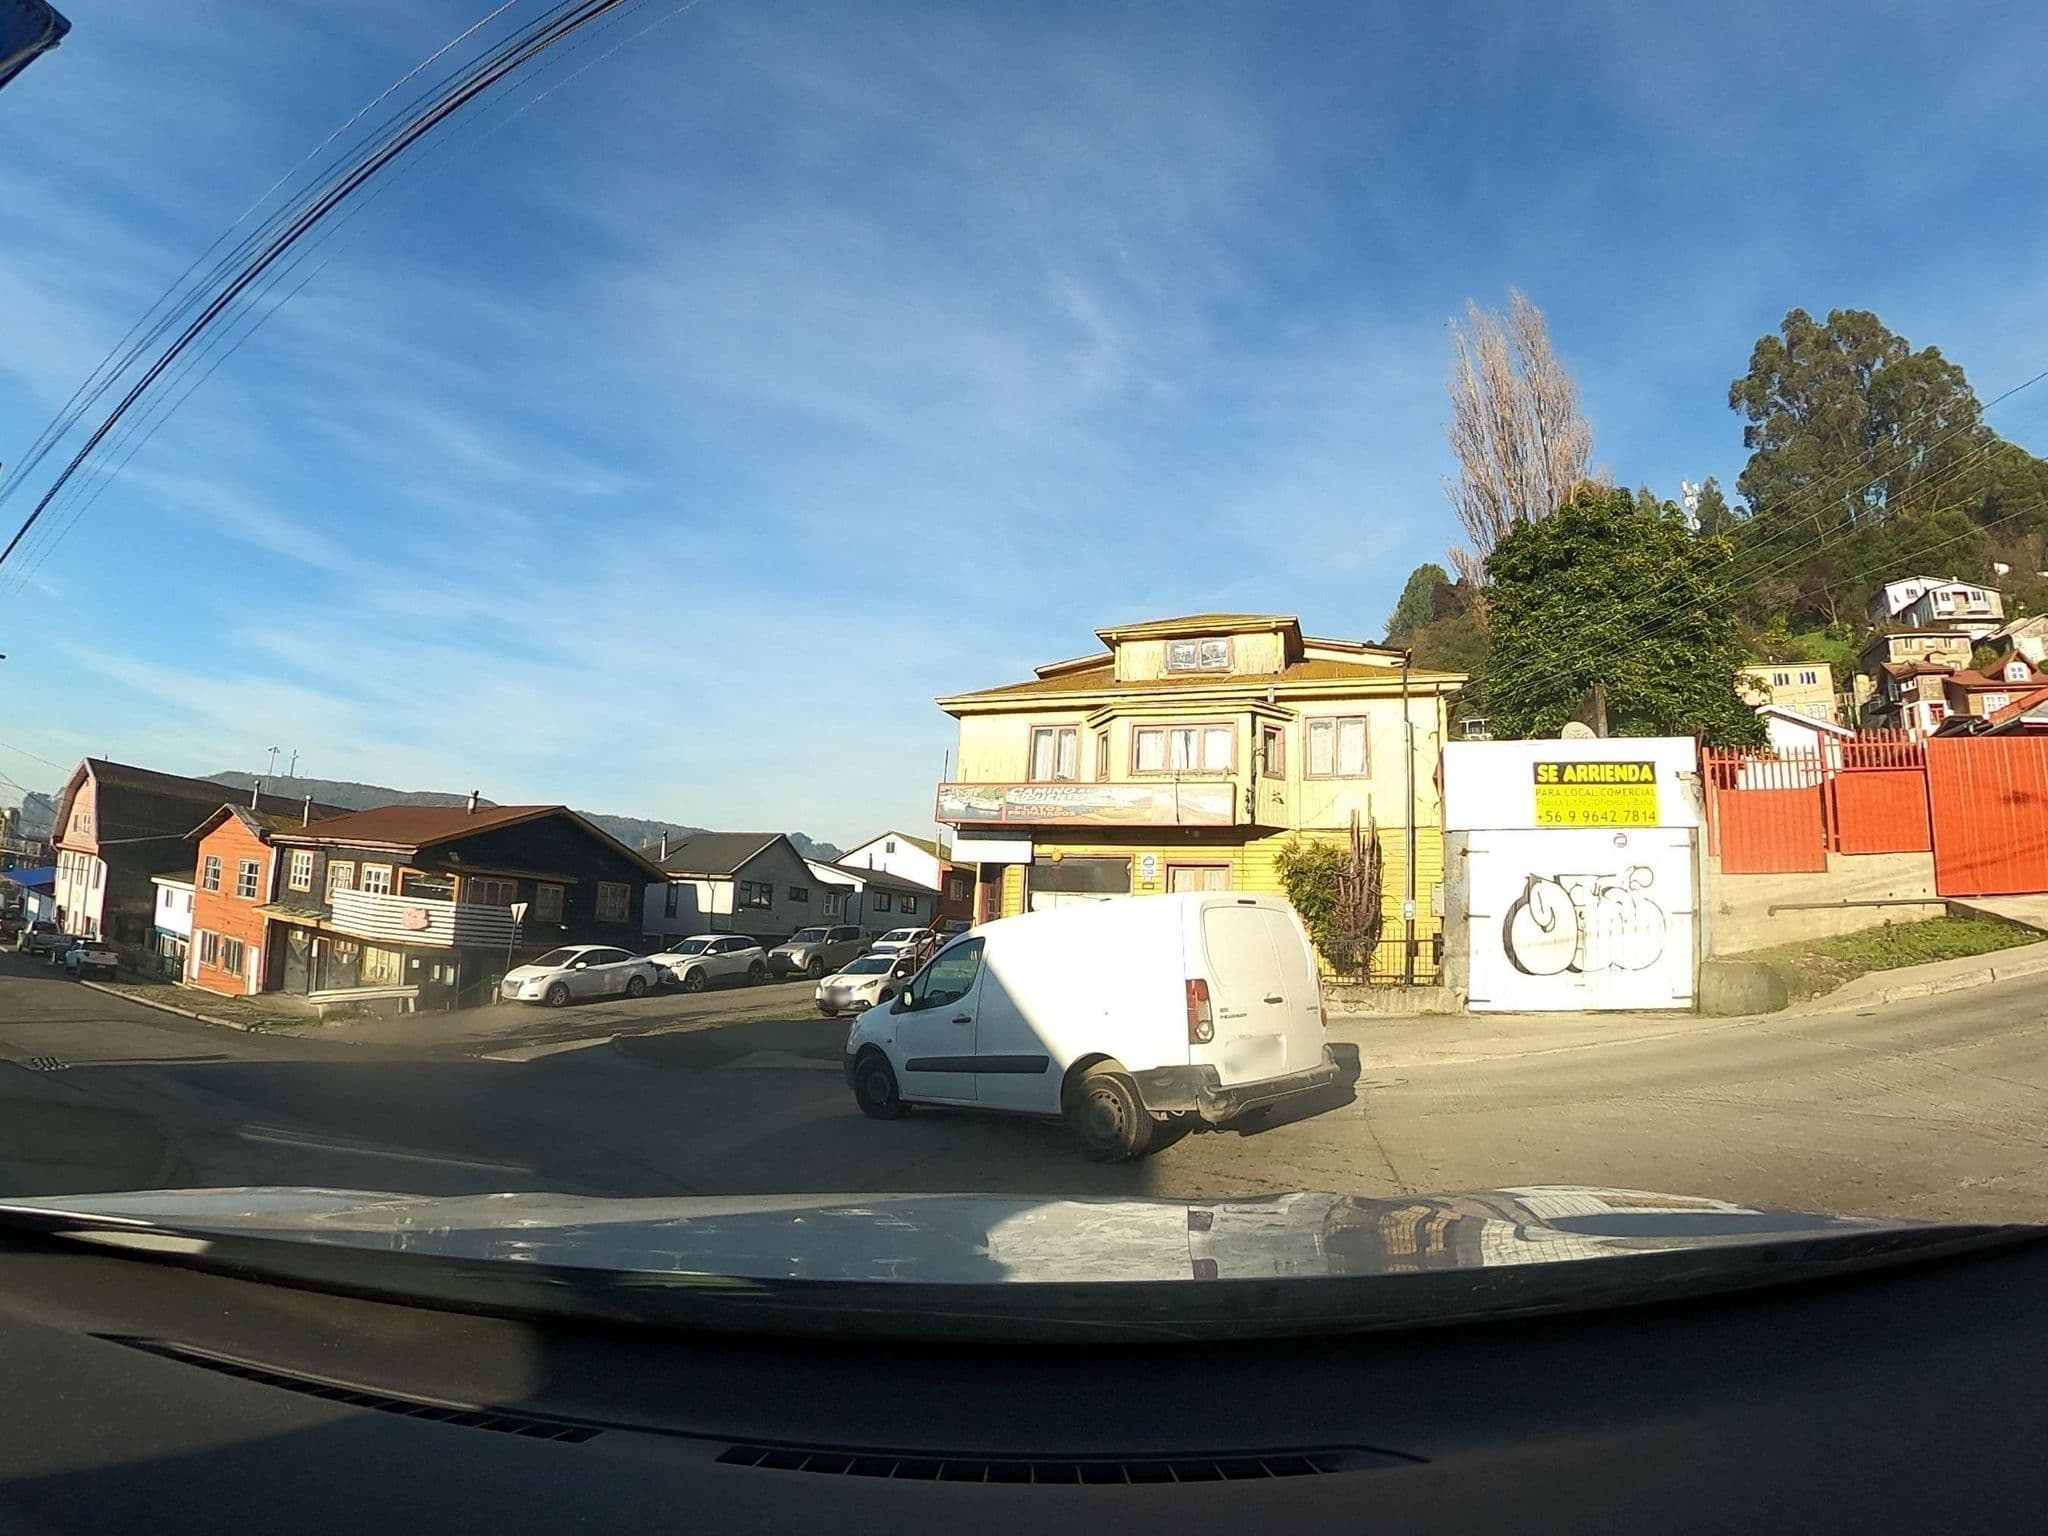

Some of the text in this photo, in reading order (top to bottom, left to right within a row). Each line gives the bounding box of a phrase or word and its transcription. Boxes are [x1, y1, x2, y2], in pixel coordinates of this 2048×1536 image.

[1537, 764, 1653, 782] SE ARRIENDA
[1008, 787, 1076, 796] CAMINO
[1536, 788, 1657, 796] PARA LOCAL COMERCIAL
[1537, 810, 1656, 822] +56 9 9642 7814
